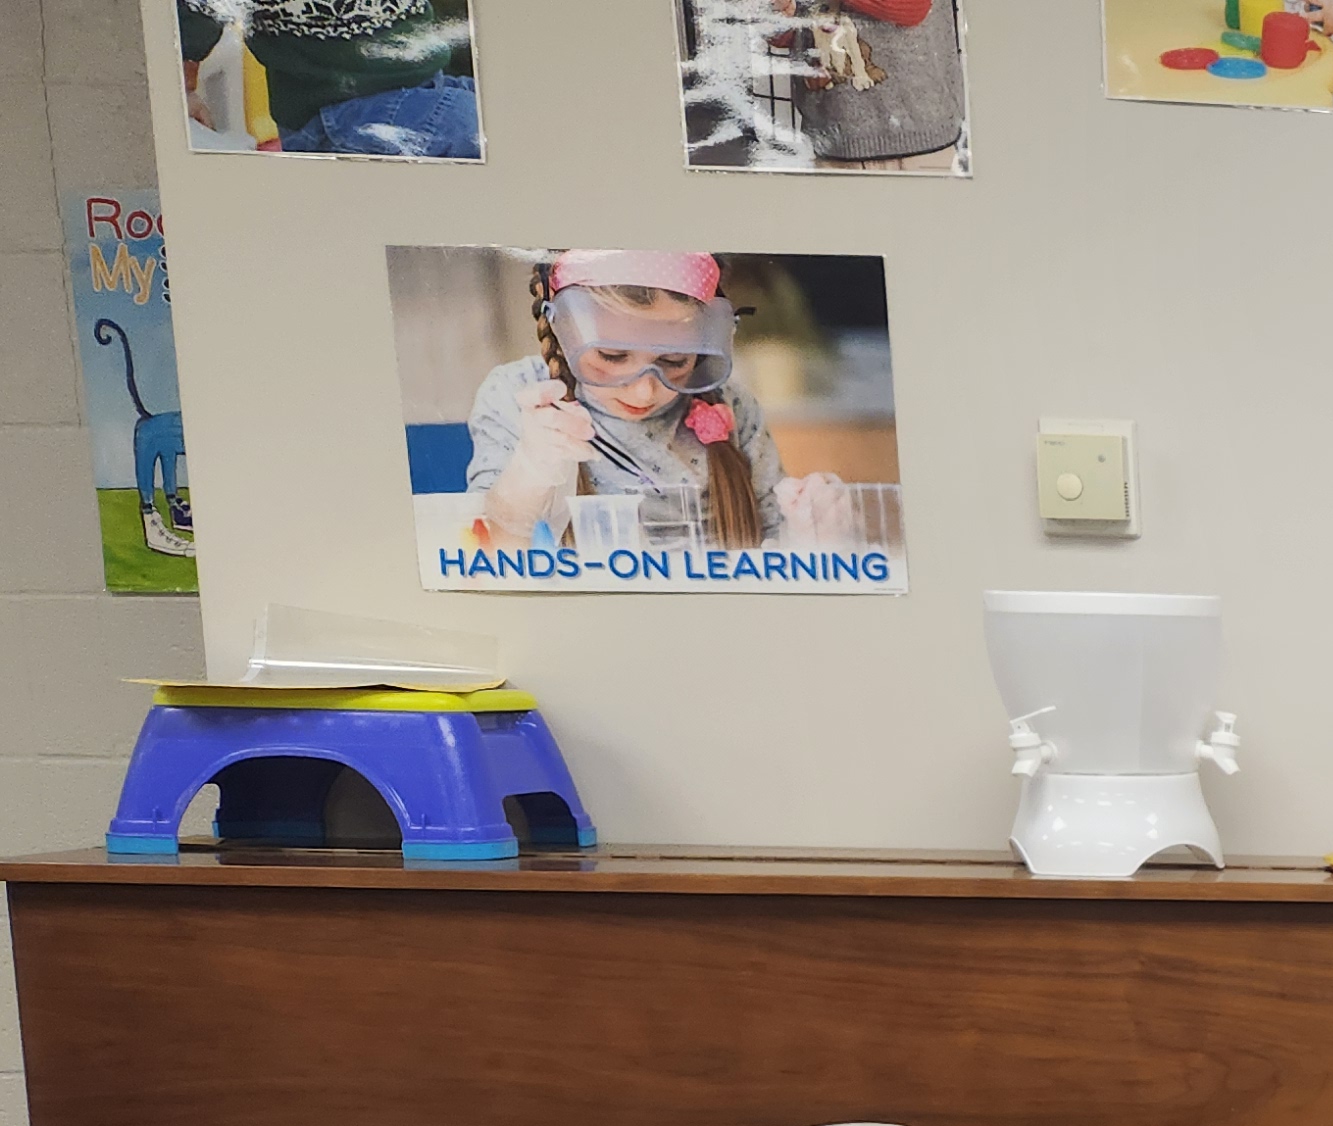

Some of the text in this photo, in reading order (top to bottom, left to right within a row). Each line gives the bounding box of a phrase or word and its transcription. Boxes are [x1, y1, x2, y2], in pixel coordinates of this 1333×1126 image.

[86, 197, 164, 240] Ro
[90, 243, 156, 305] My
[438, 547, 891, 583] HANDS-ON LEARNING
